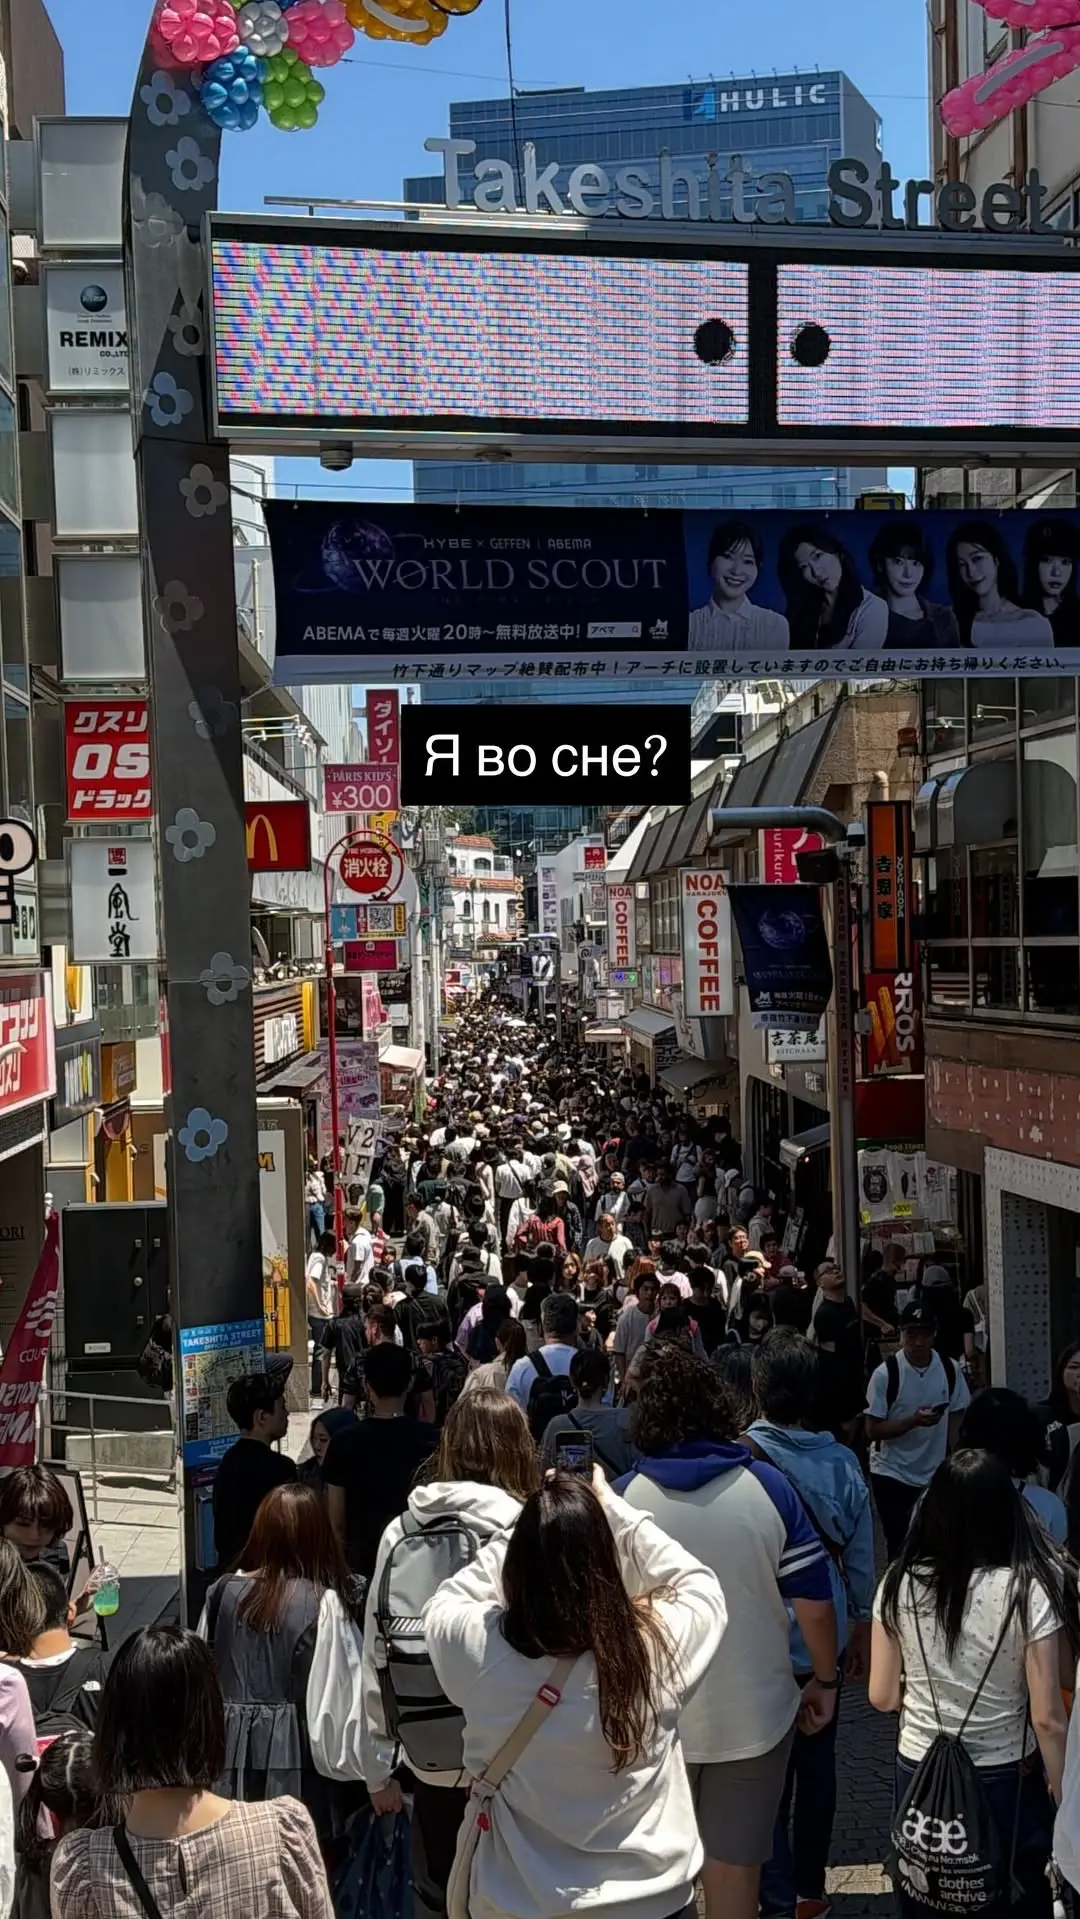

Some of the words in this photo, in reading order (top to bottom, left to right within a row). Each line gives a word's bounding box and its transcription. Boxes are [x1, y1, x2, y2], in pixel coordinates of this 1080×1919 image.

[720, 84, 826, 112] HULIC
[424, 137, 796, 224] Takeshita
[828, 157, 1053, 234] Street
[60, 330, 128, 347] REMIX
[423, 538, 472, 549] HYBE
[489, 537, 531, 550] GEFFEN
[547, 537, 592, 550] ABEMA
[352, 558, 516, 591] WORLD
[528, 558, 668, 591] SCOUT
[73, 711, 148, 733] クスリ
[72, 743, 150, 780] OS
[332, 771, 362, 782] PARIS
[363, 770, 392, 782] KID'S
[72, 789, 151, 809] ドラッグ
[331, 784, 391, 808] ¥300
[344, 857, 389, 878] 消火栓
[609, 887, 632, 897] NOA
[686, 874, 725, 891] NOA
[107, 868, 140, 957] 一風堂
[615, 901, 629, 966] COFFEE
[697, 899, 720, 1011] COFFEE
[184, 1333, 229, 1348] TAKESHITA
[230, 1328, 262, 1340] STREET
[938, 1876, 985, 1890] clothes
[940, 1890, 988, 1903] archive
